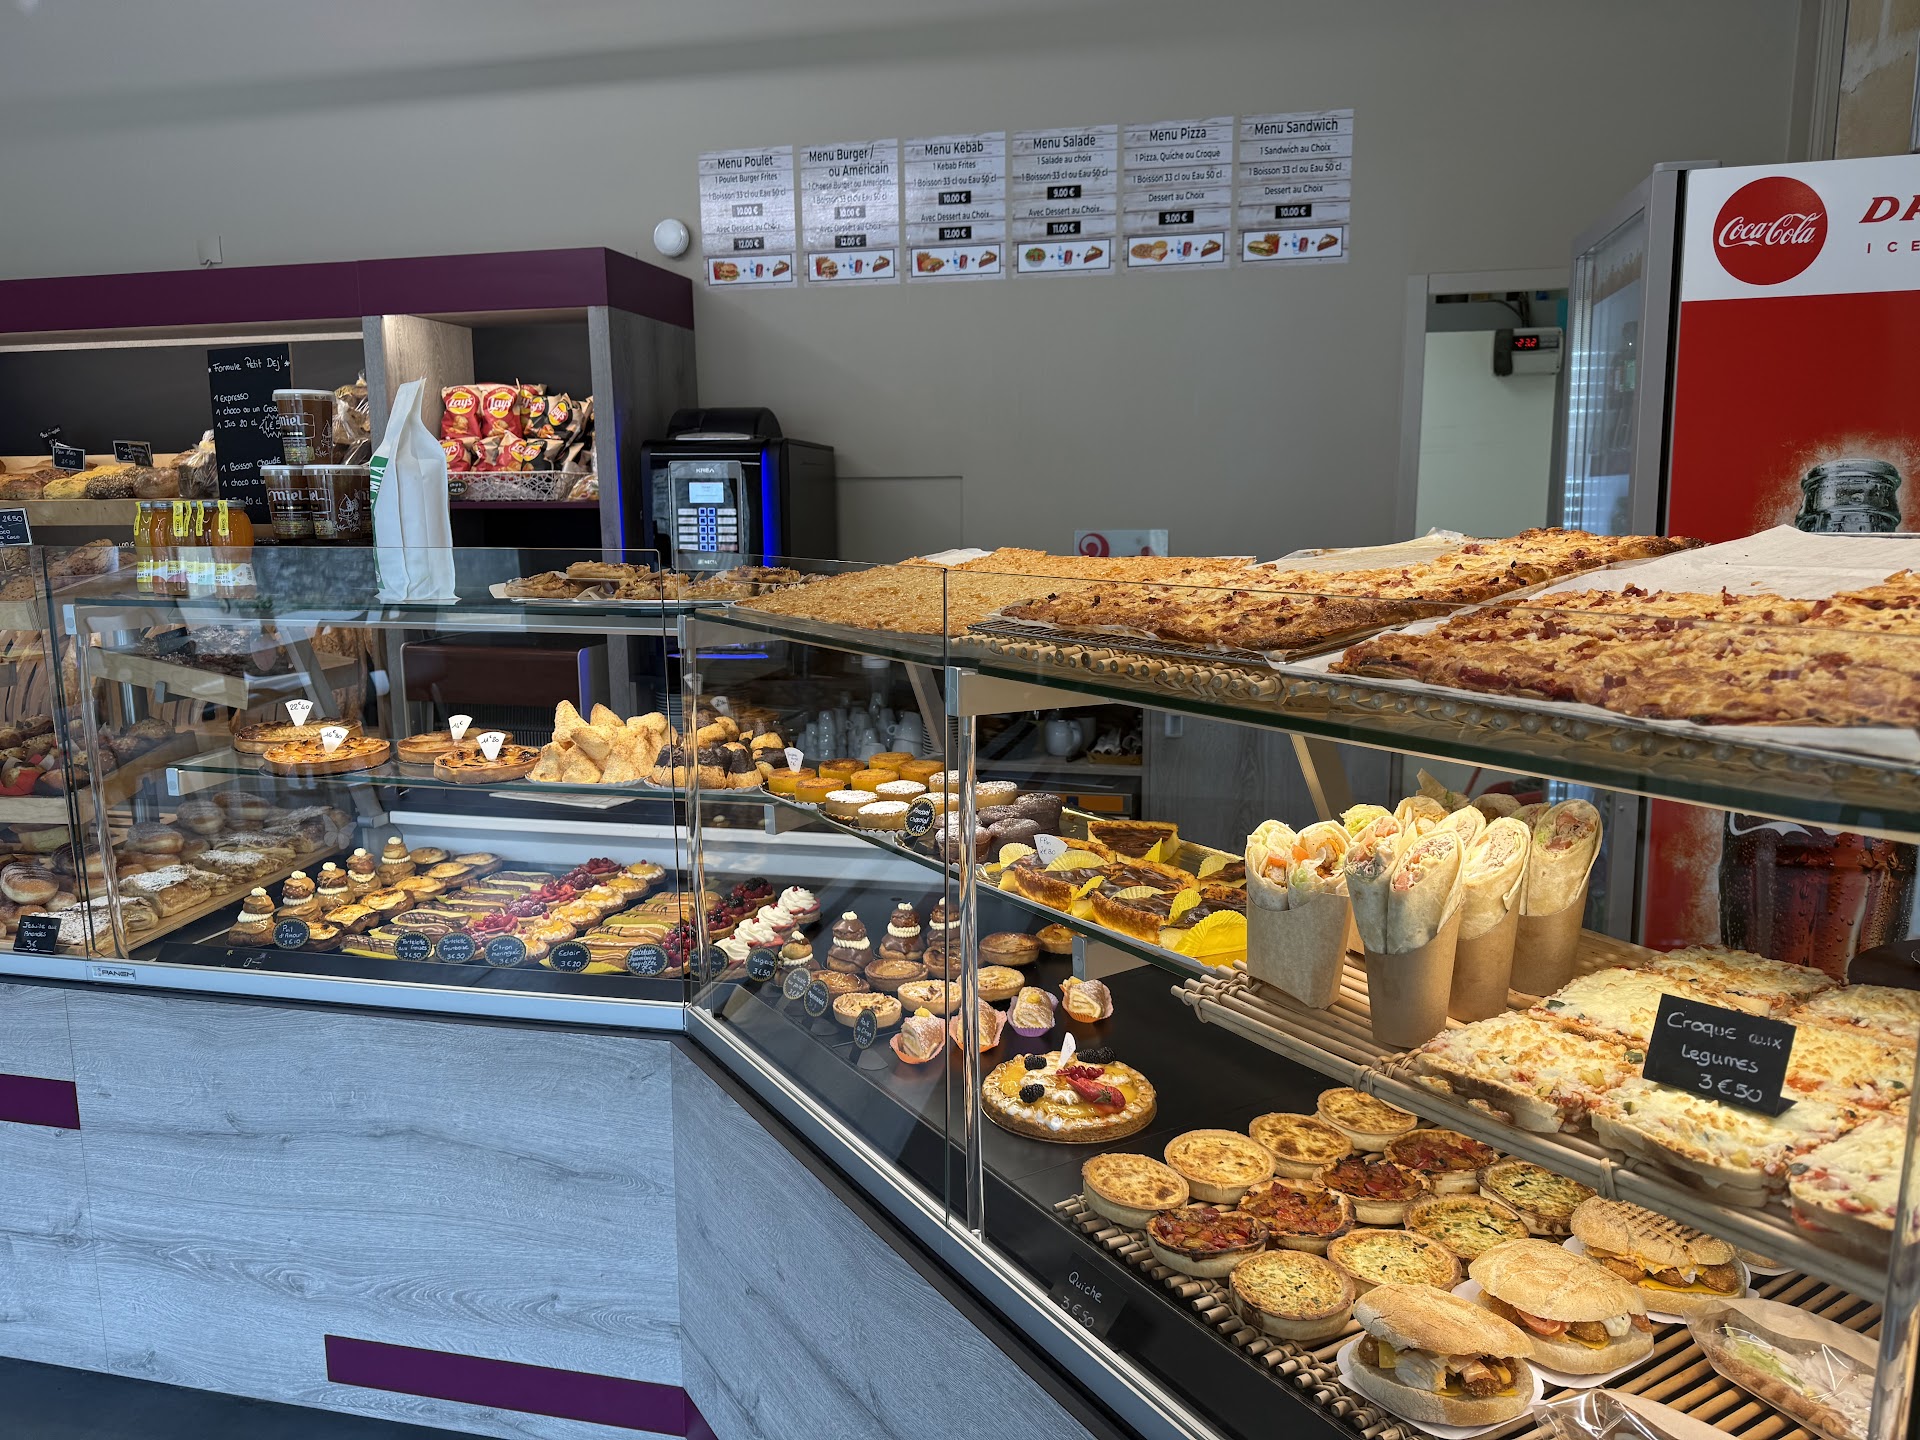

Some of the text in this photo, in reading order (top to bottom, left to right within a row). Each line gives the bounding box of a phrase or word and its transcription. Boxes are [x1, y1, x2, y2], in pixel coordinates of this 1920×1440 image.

[1254, 118, 1338, 135] Menu Sandwich
[1149, 126, 1206, 142] Menu Pizza
[1033, 134, 1096, 150] Menu Salade
[924, 141, 983, 156] Menu Kebab
[1264, 145, 1299, 155] Sandwich
[1311, 143, 1331, 152] Choix
[809, 149, 868, 163] Menu Burger
[1041, 156, 1063, 165] Salade
[1074, 154, 1091, 163] choix
[1160, 150, 1184, 161] Quiche
[1195, 149, 1220, 159] Croque
[717, 155, 773, 169] Menu Poulet
[937, 160, 976, 170] Kebab Frites
[828, 161, 889, 178] ou Américain
[1026, 172, 1050, 181] Boisson
[1052, 171, 1060, 179] 33
[1061, 170, 1068, 178] cl
[1078, 170, 1091, 178] Eau
[1092, 169, 1101, 177] 50
[1102, 168, 1108, 176] cl
[1253, 167, 1280, 176] Boisson
[1281, 166, 1290, 174] 33
[1292, 165, 1298, 174] cl
[1310, 164, 1324, 173] Eau
[1325, 163, 1334, 172] 50
[1335, 162, 1342, 171] cl
[719, 172, 778, 184] Poulet Burger Frites
[917, 178, 941, 187] Boisson
[968, 176, 980, 184] Eau
[981, 175, 990, 183] 50
[991, 174, 997, 182] cl
[1137, 170, 1222, 183] Boisson 33 cl ou Eau 50 cl
[1053, 187, 1075, 197] 9.00 €
[1265, 186, 1290, 195] Dessert
[1303, 183, 1323, 193] Choix
[712, 191, 735, 201] Boisson
[943, 193, 966, 203] 10.00 €
[1148, 194, 1174, 203] Dessert
[1185, 191, 1204, 200] Choix
[921, 214, 936, 222] Avec
[937, 212, 960, 221] Dessert
[971, 211, 989, 219] Choix
[1028, 209, 1044, 217] Avec
[1045, 207, 1069, 216] Dessert
[1081, 205, 1100, 214] Choix
[1281, 206, 1306, 217] 10.00 €
[1164, 213, 1188, 223] 9.00 €
[944, 229, 967, 239] 12.00 €
[1052, 223, 1075, 233] 11.00 €
[1718, 212, 1824, 248] Coca-Cola
[754, 239, 760, 248] €
[212, 362, 242, 373] Formule
[244, 357, 262, 369] Petit
[220, 392, 249, 405] Expresso
[222, 407, 241, 415] choco
[224, 419, 236, 428] Jus
[229, 462, 253, 472] Boisson
[256, 456, 282, 468] Chaude
[230, 478, 249, 486] choco
[101, 970, 135, 978] PANEM
[752, 967, 771, 977] 3€50
[1667, 1012, 1783, 1050] Croque aux
[1681, 1043, 1759, 1074] Legumes
[1698, 1073, 1763, 1103] 3€50
[1068, 1271, 1103, 1304] Quiche
[1060, 1295, 1095, 1328] 3€50
